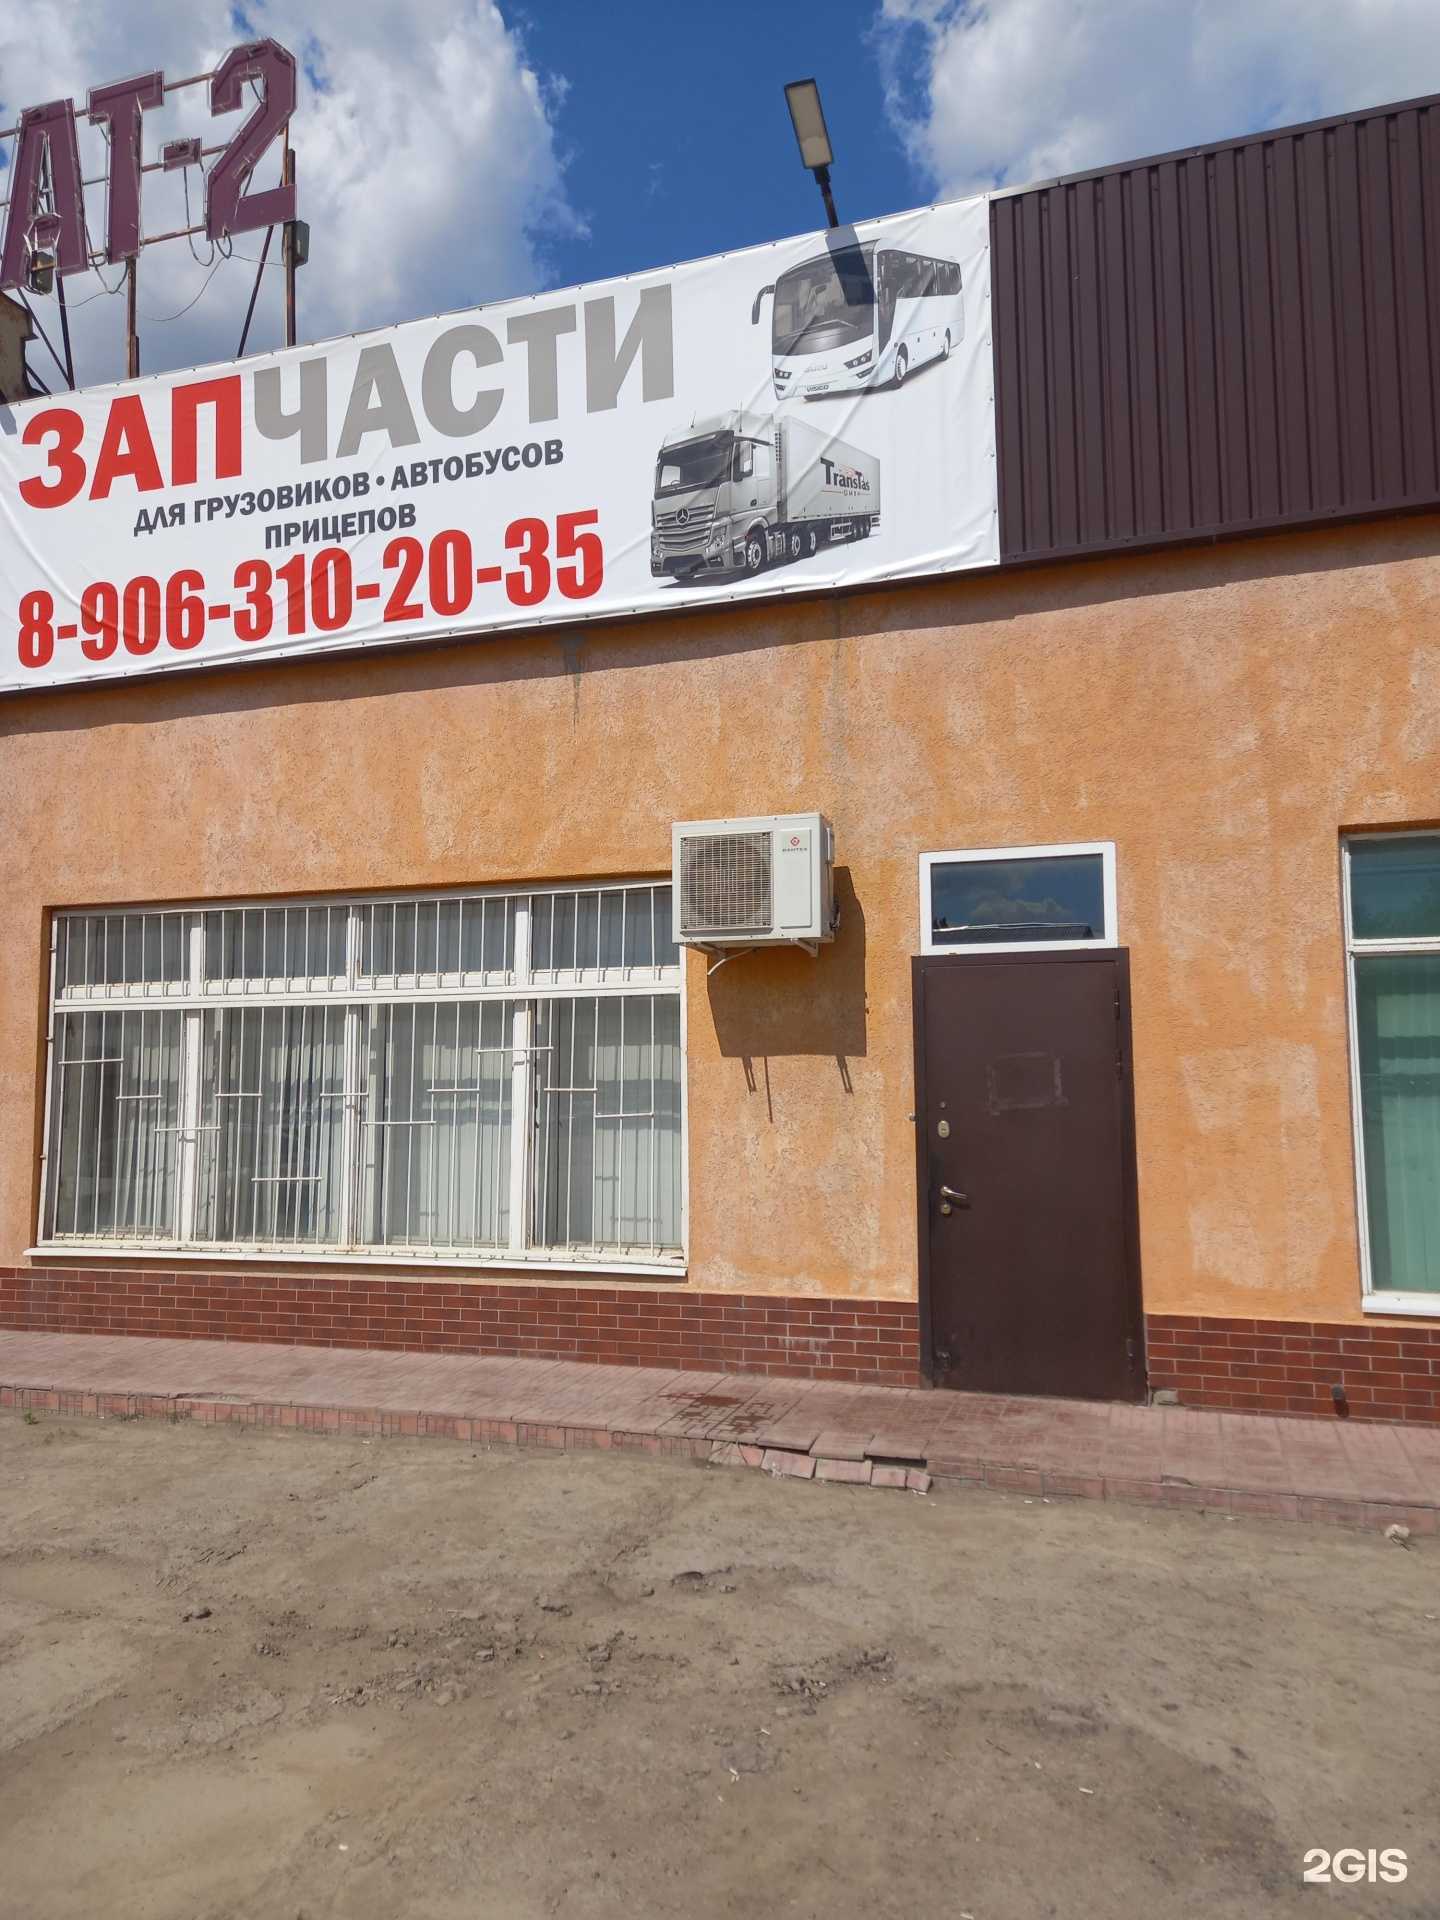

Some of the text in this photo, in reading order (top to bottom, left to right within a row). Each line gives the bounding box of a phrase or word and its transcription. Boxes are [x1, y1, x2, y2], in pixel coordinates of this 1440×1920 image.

[19, 283, 674, 509] ЗАПЧАСТИ
[133, 438, 564, 537] ДЛЯ ГРУЗОВИКОВ АВТОБУСОВ
[264, 502, 417, 550] ПРИЦЕПОВ
[17, 508, 604, 669] 8-906-310-20-35
